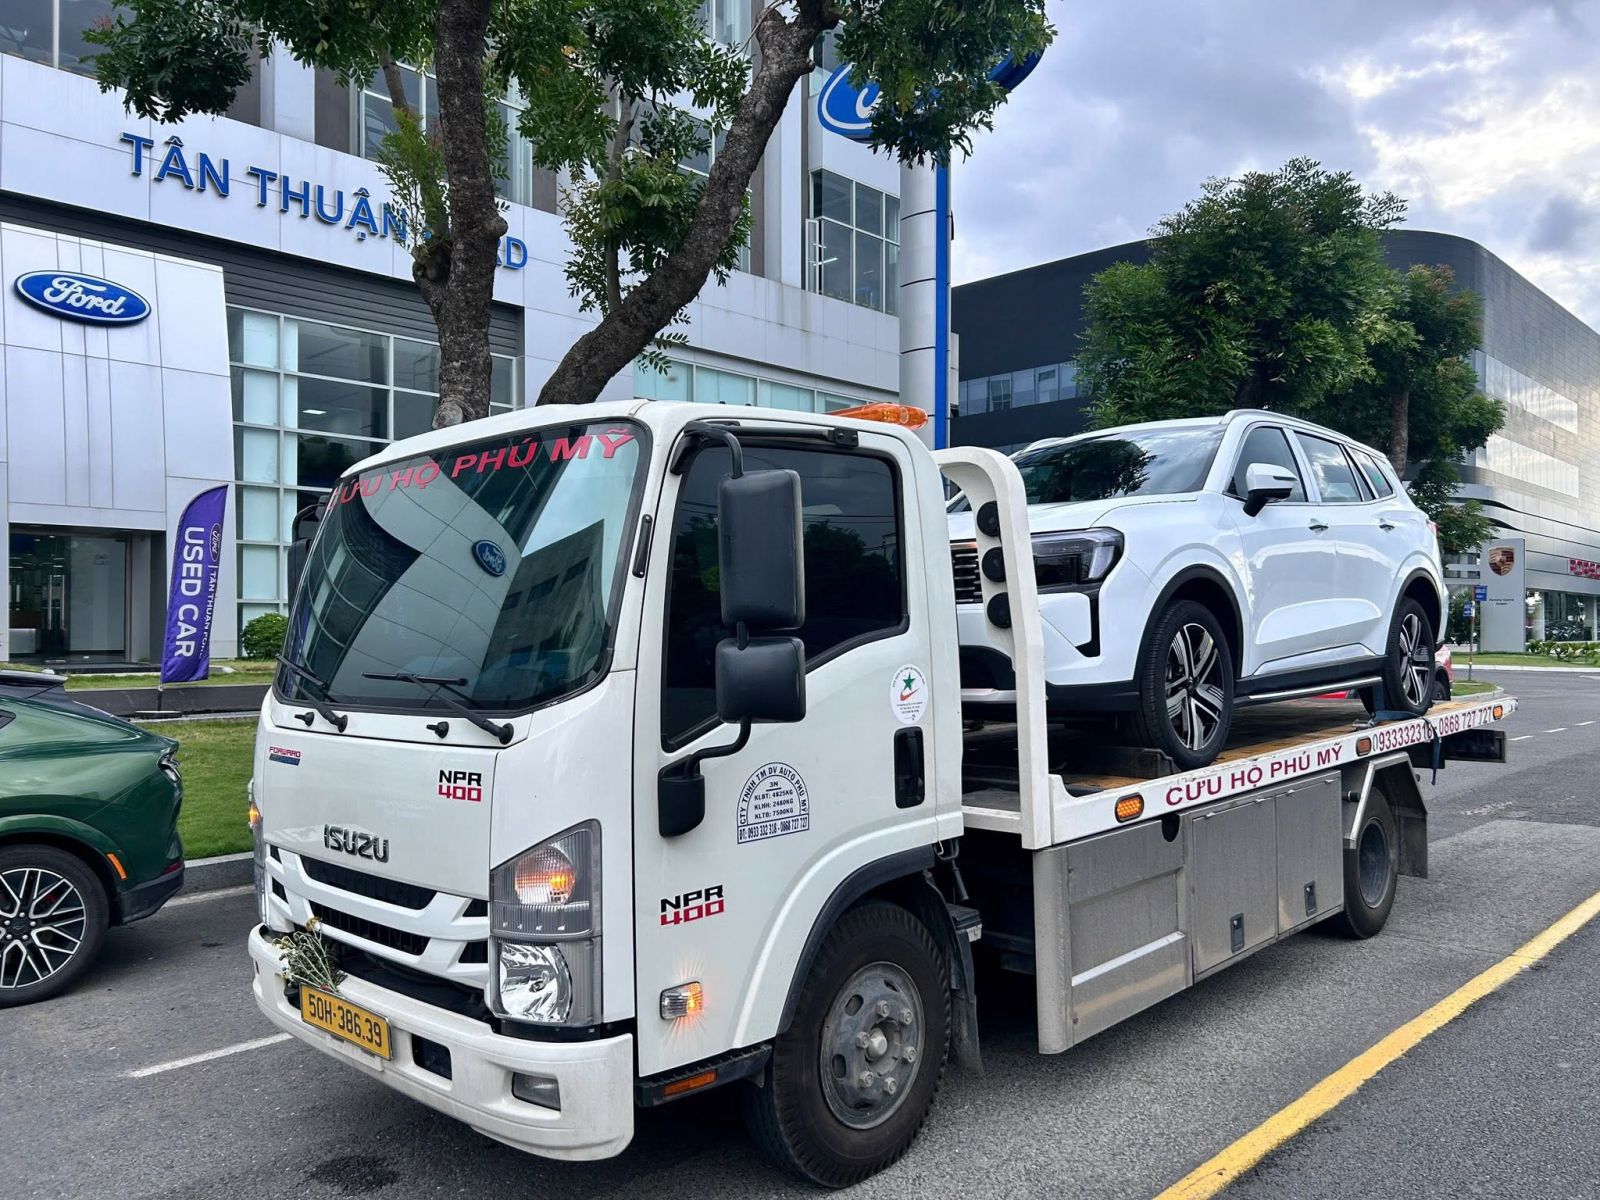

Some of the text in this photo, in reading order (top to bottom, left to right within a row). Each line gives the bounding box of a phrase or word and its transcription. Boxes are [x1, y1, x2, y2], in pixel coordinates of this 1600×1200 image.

[120, 132, 407, 241] TÂN THUẬN
[43, 277, 127, 315] Ford
[452, 438, 537, 478] PHÚ
[550, 428, 635, 462] MỸ
[175, 527, 204, 656] USED CAR
[1439, 714, 1459, 735] 0868
[1462, 711, 1476, 730] 727
[1479, 707, 1492, 724] 727
[439, 770, 482, 786] NPR
[1270, 751, 1310, 778] PHÚ
[1317, 742, 1342, 766] MỸ
[438, 785, 482, 802] 400
[742, 780, 756, 802] TNHH
[756, 770, 766, 780] TM
[768, 766, 777, 774] DV
[779, 767, 796, 780] AUTO
[754, 802, 771, 810] KLHH:
[772, 808, 794, 816] 7500KG
[324, 824, 390, 863] ISUZU
[661, 885, 724, 912] NPR
[661, 900, 724, 926] 400
[308, 993, 382, 1048] 50H-386.39
